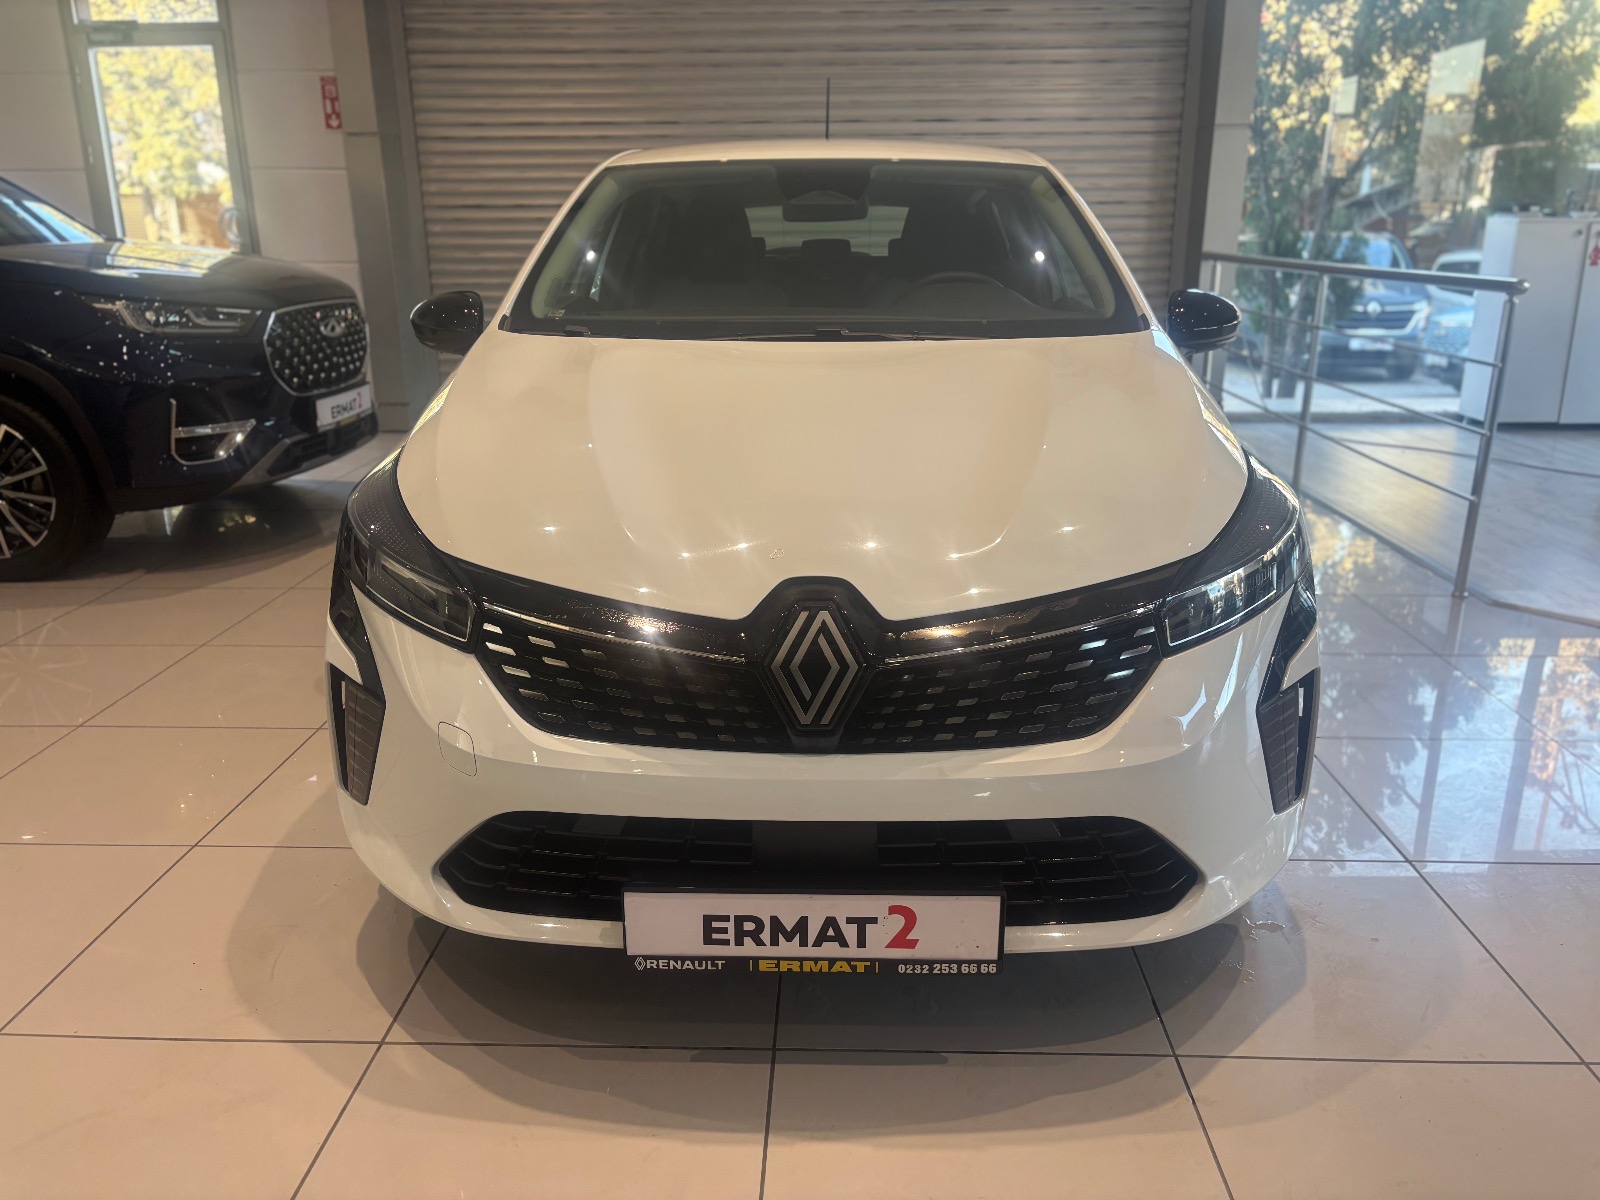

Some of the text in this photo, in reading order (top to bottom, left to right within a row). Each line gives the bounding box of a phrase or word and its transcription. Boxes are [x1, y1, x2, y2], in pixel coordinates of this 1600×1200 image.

[702, 904, 919, 950] ERMAT 2
[646, 959, 726, 971] RENAULT
[758, 959, 871, 973] ERMAT
[898, 963, 997, 974] 0232 253 66 66
